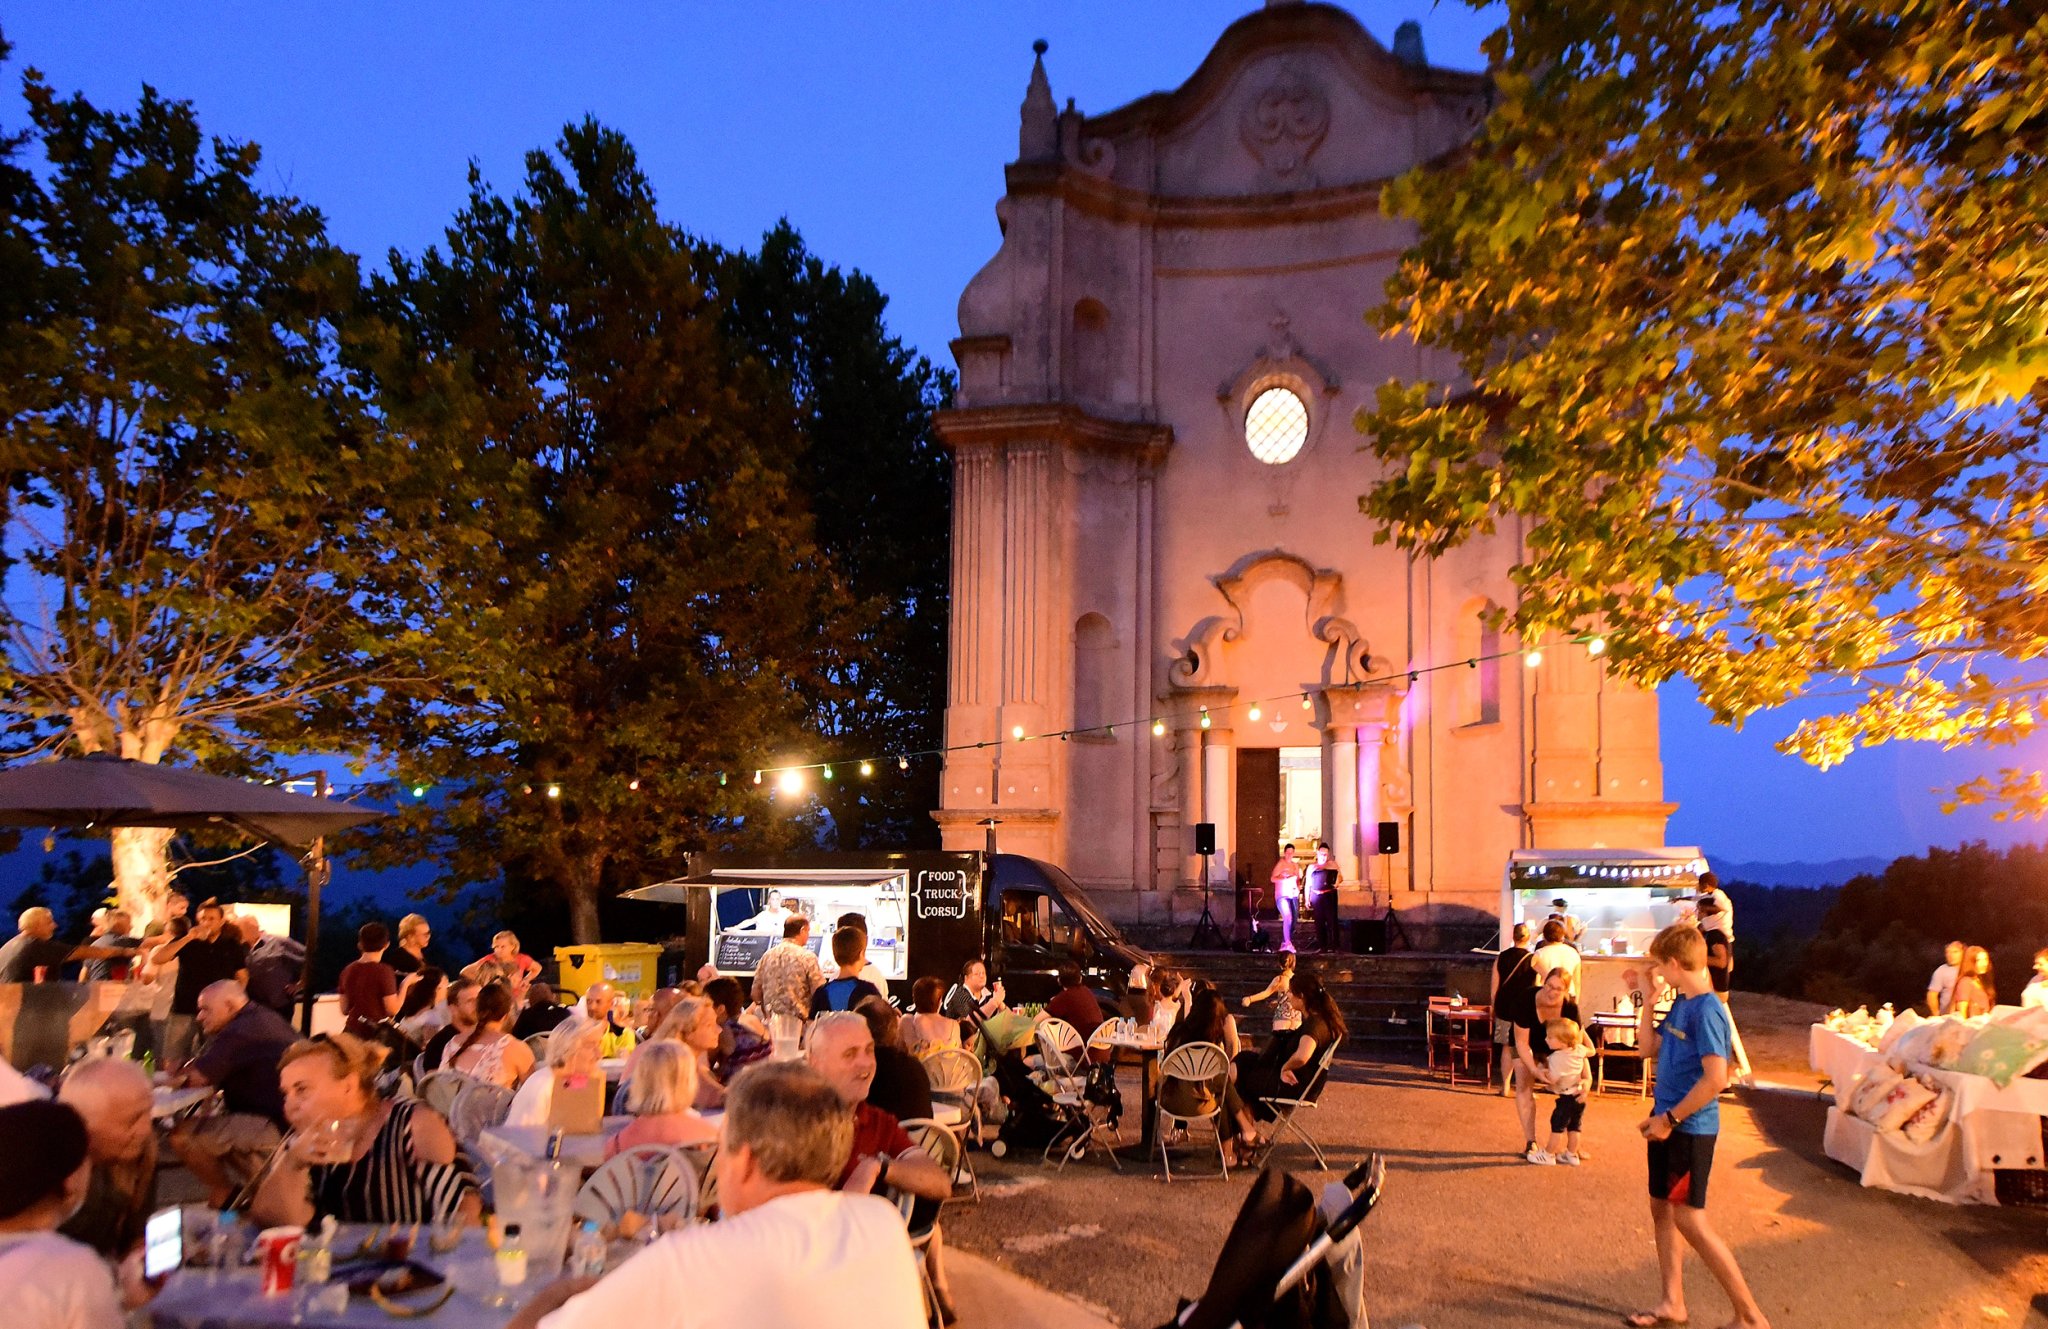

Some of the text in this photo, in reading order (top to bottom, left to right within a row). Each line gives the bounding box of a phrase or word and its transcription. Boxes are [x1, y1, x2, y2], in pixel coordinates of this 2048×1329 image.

[928, 871, 956, 881] FOOD
[924, 889, 958, 899] TRUCK
[924, 906, 958, 917] CORSU
